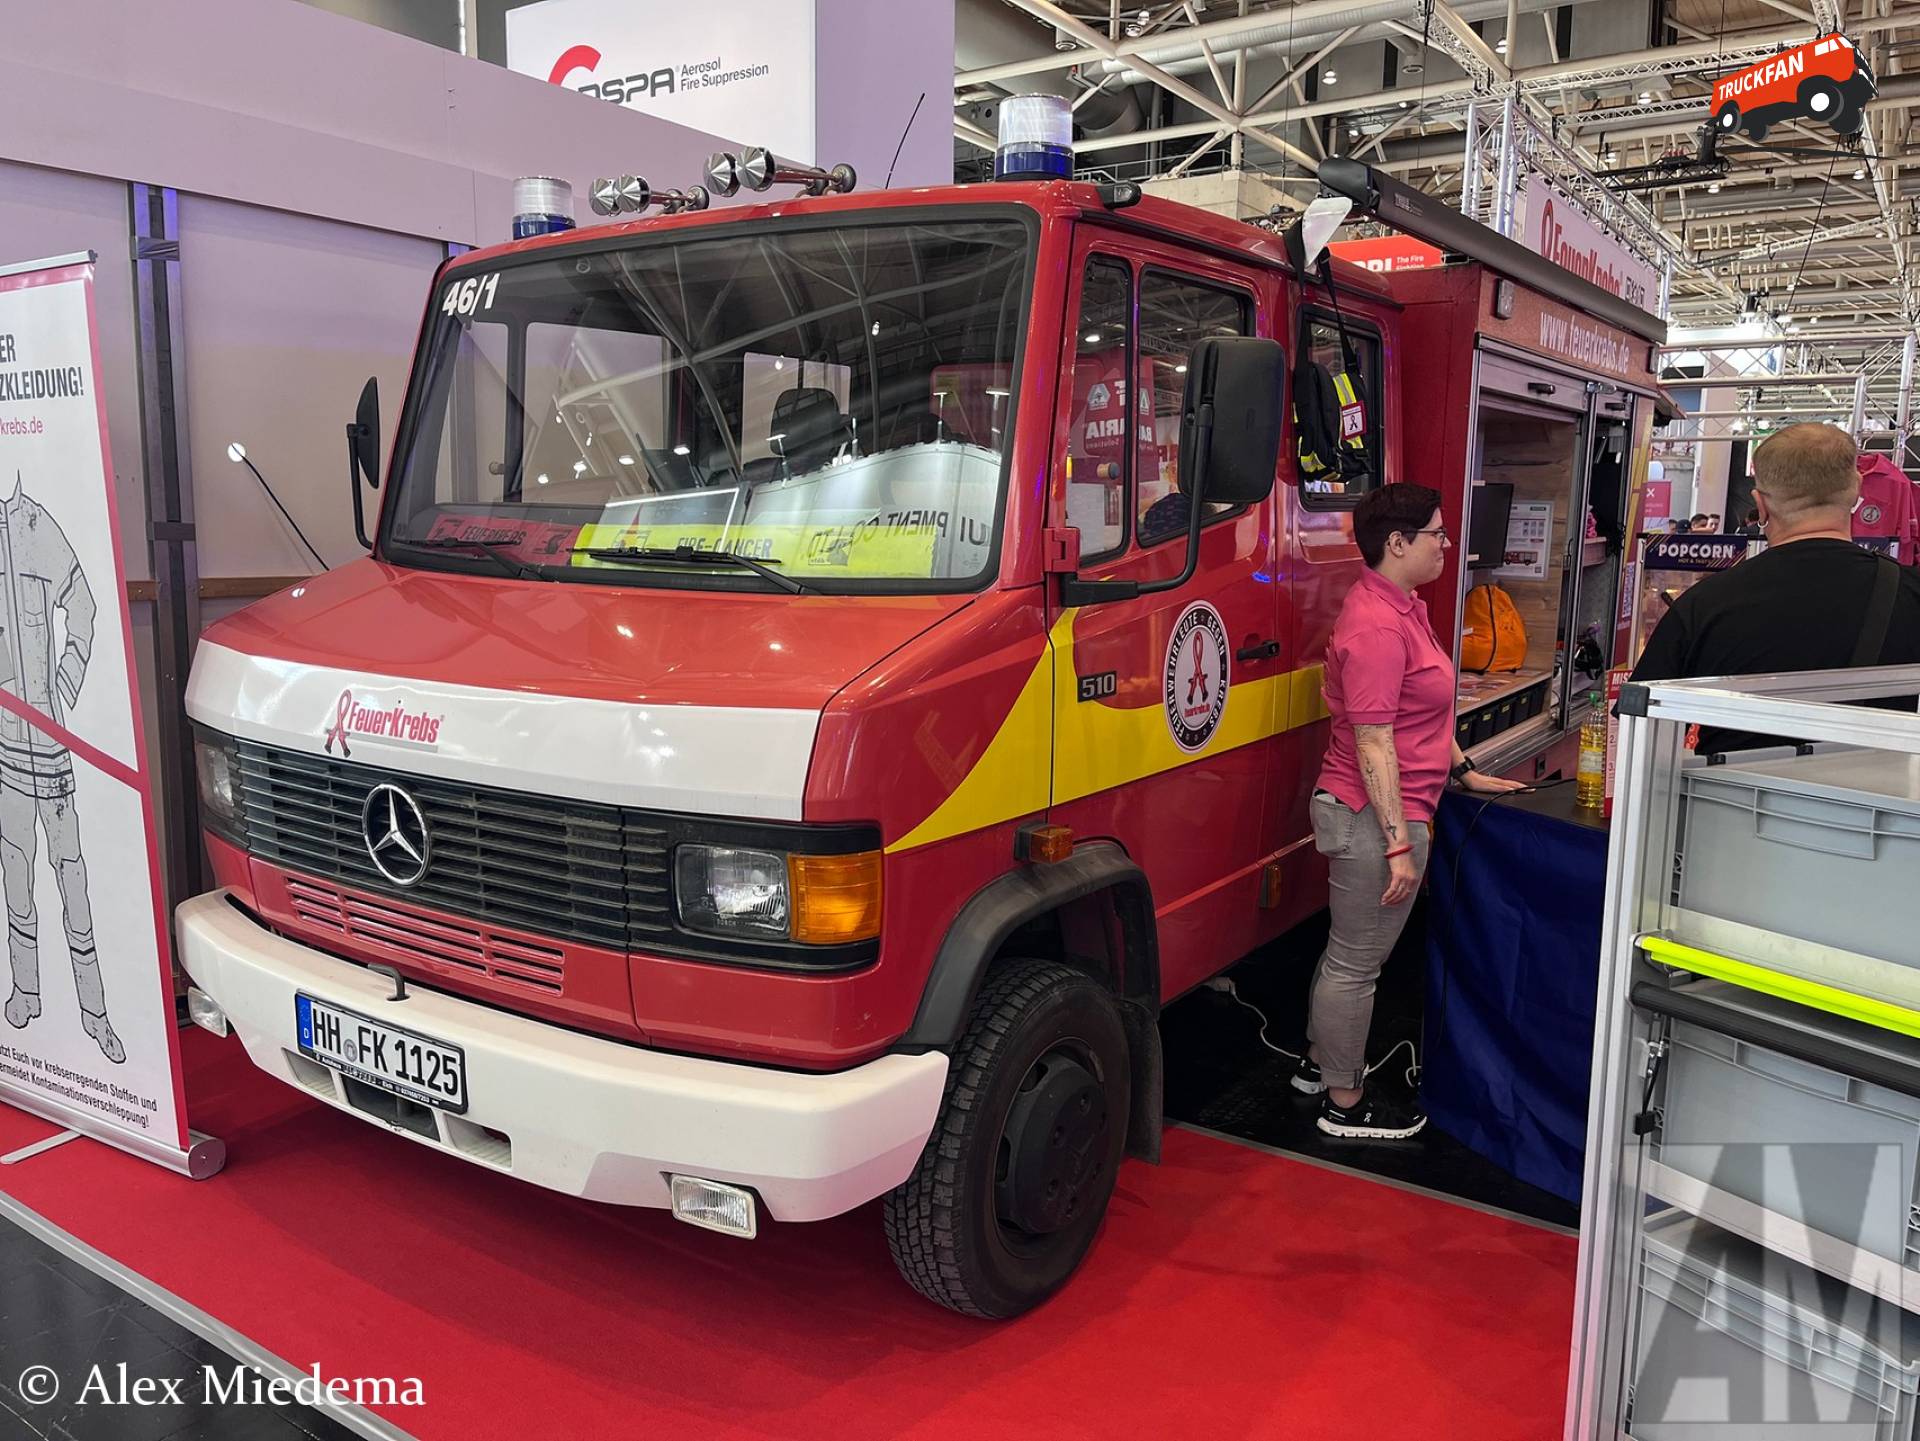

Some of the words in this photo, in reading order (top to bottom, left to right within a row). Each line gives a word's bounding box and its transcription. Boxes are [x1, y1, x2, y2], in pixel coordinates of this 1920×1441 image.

[680, 56, 722, 78] Aerosol
[680, 73, 701, 92] Fire
[701, 64, 770, 88] Suppression
[442, 272, 500, 317] 46/1
[1540, 311, 1630, 375] www.feuerkrebs.de
[1658, 543, 1734, 559] POPCORN
[1207, 615, 1225, 656] GEGEN
[1081, 673, 1116, 698] 510
[1167, 611, 1199, 739] FEUERWEHRLEUTE
[348, 700, 440, 744] FeuerKrebs
[1209, 679, 1227, 728] KREBS
[303, 1027, 310, 1039] D
[312, 1008, 342, 1055] HH
[357, 1025, 389, 1074] FK
[394, 1038, 459, 1097] 1125
[11, 1047, 30, 1065] Euch
[31, 1057, 44, 1070] vor
[43, 1058, 110, 1094] krebserregenden
[109, 1082, 140, 1105] Stoffen
[140, 1097, 158, 1113] und
[30, 1071, 151, 1129] Kontaminationsverschleppung!
